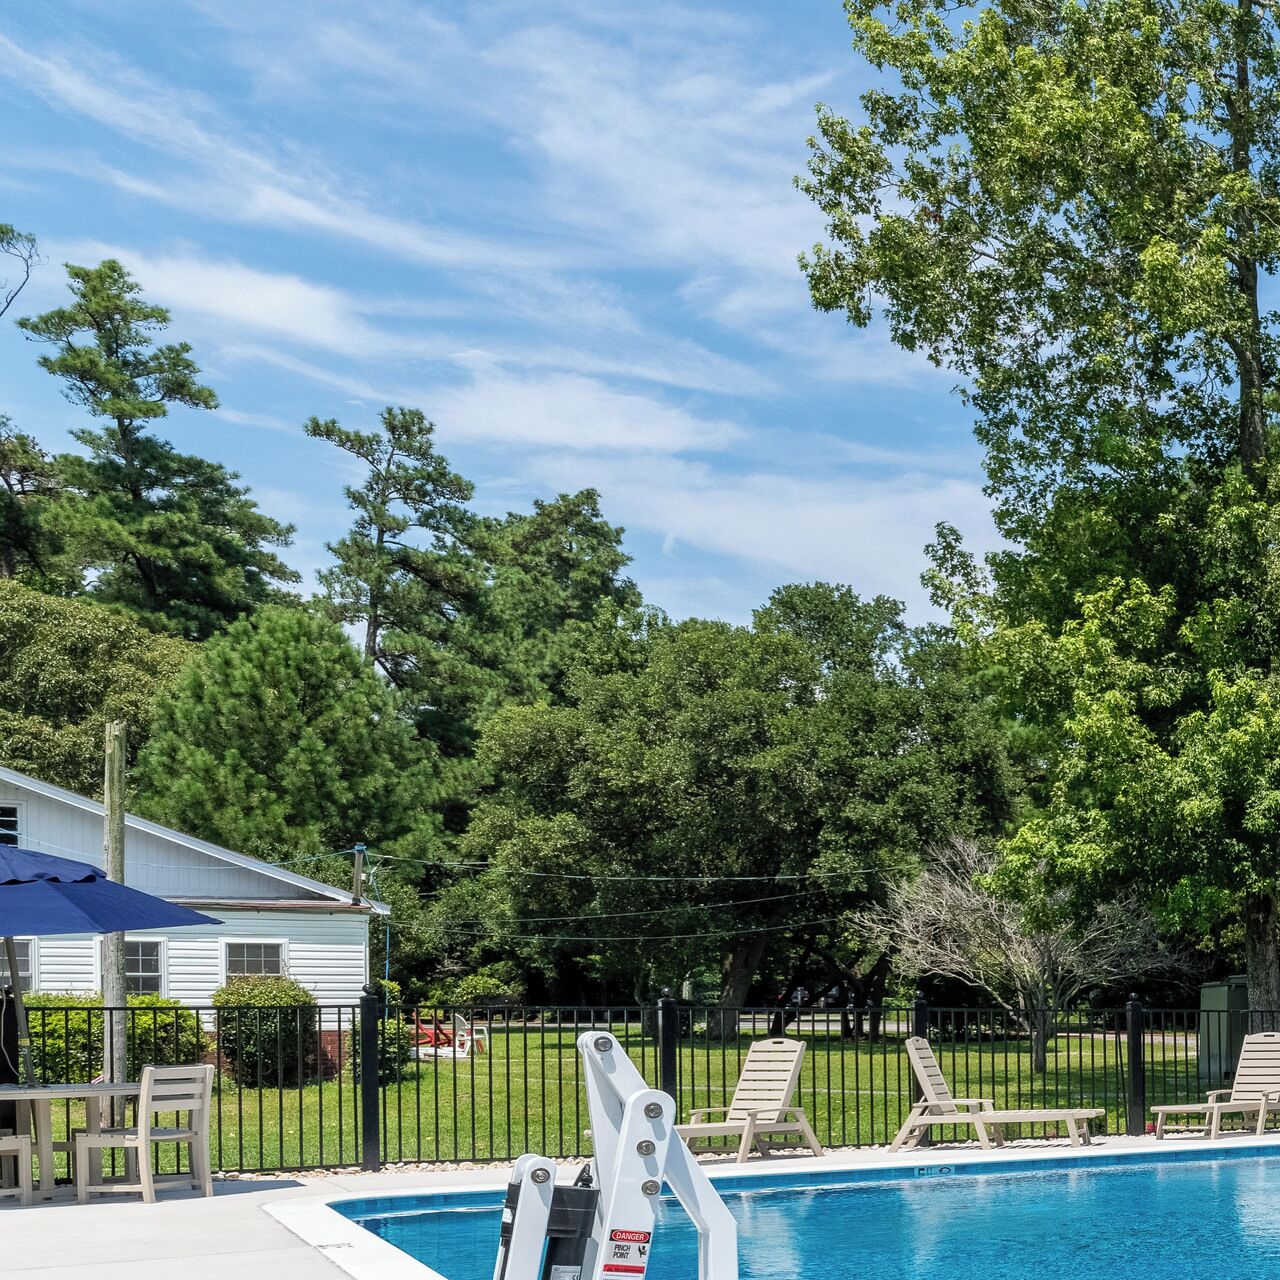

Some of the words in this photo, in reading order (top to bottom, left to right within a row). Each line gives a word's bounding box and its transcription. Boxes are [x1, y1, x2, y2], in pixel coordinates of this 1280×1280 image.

[616, 1231, 645, 1241] DANGER
[614, 1244, 631, 1252] PINCH
[612, 1251, 630, 1259] POINT
